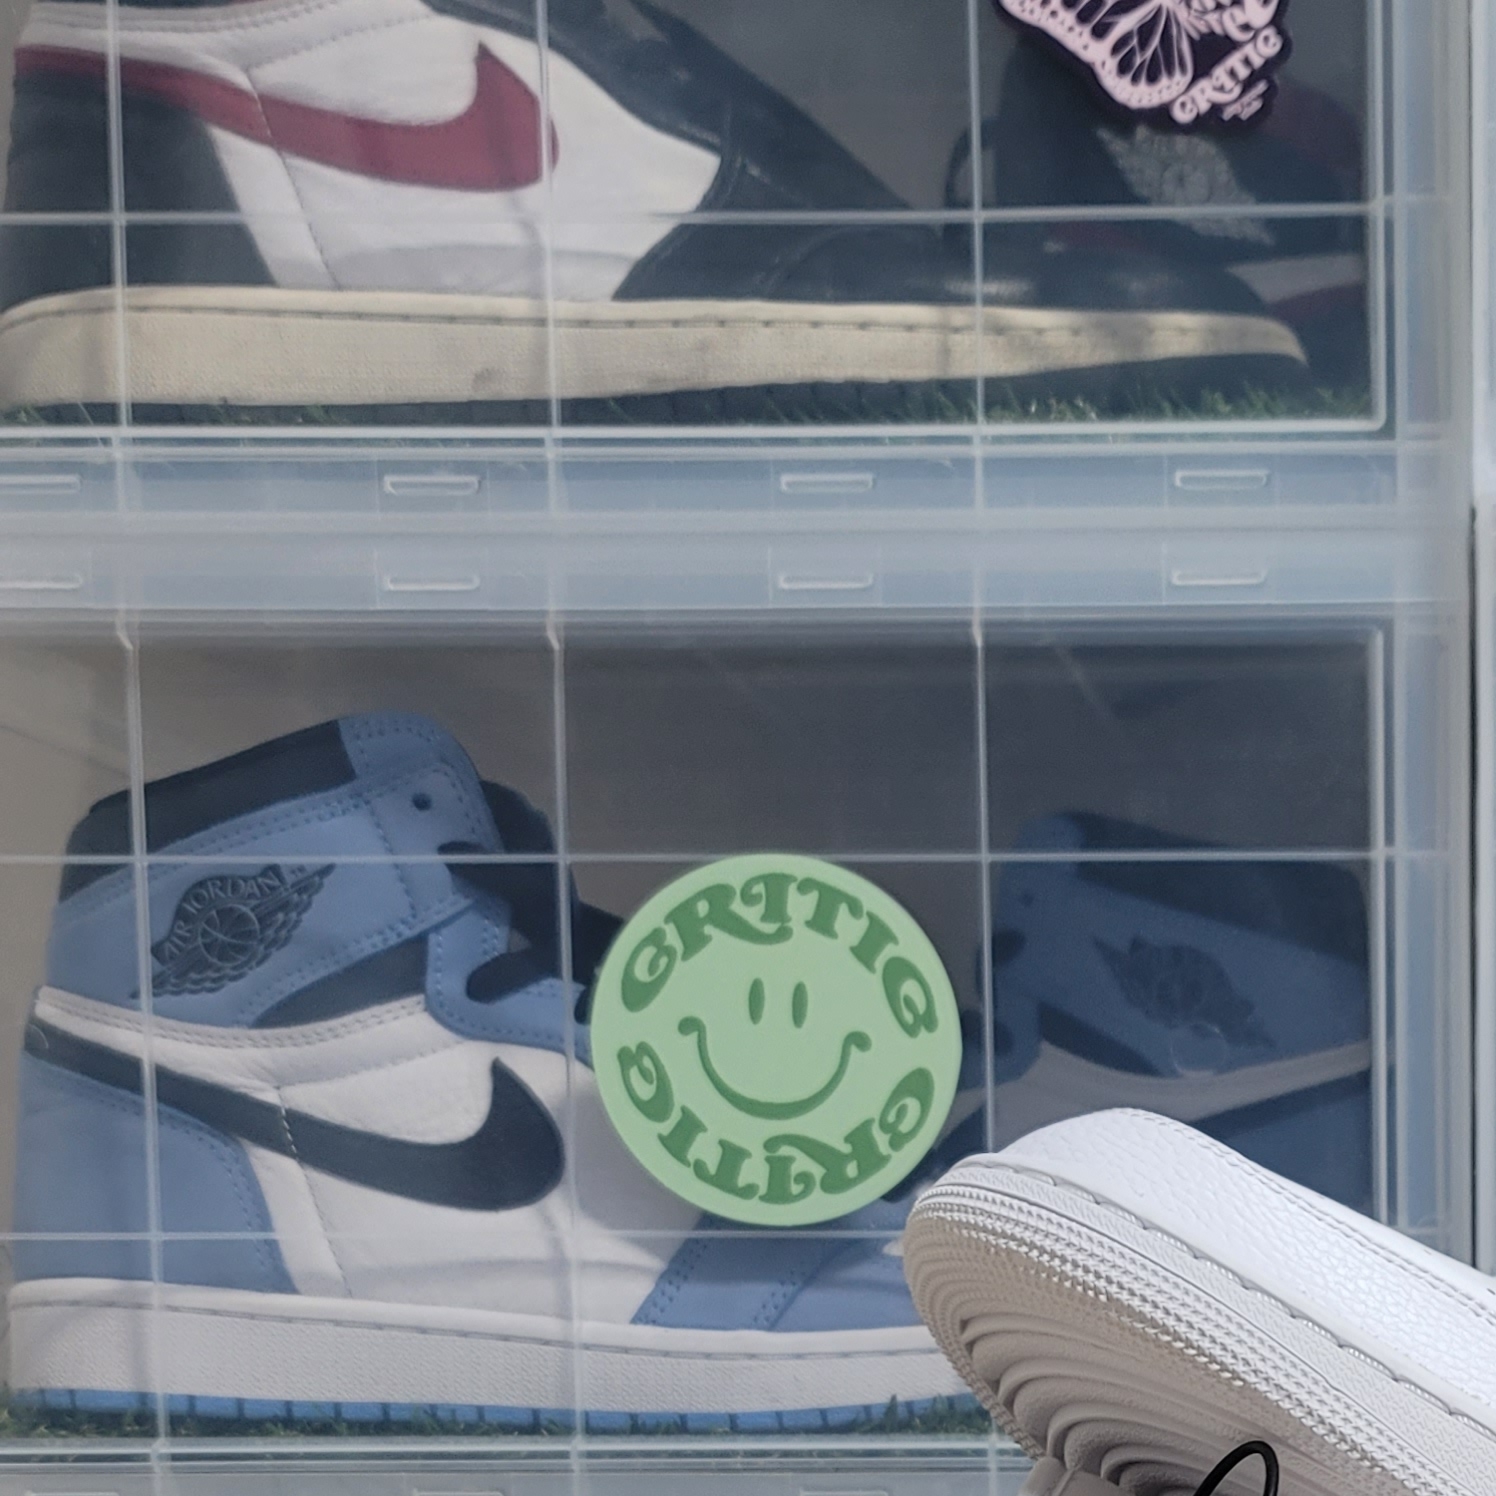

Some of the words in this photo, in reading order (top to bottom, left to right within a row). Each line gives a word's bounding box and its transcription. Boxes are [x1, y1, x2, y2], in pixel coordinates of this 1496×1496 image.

[164, 919, 193, 960] AIR
[621, 872, 938, 1038] CRITIC
[617, 1041, 935, 1204] CRITIC
